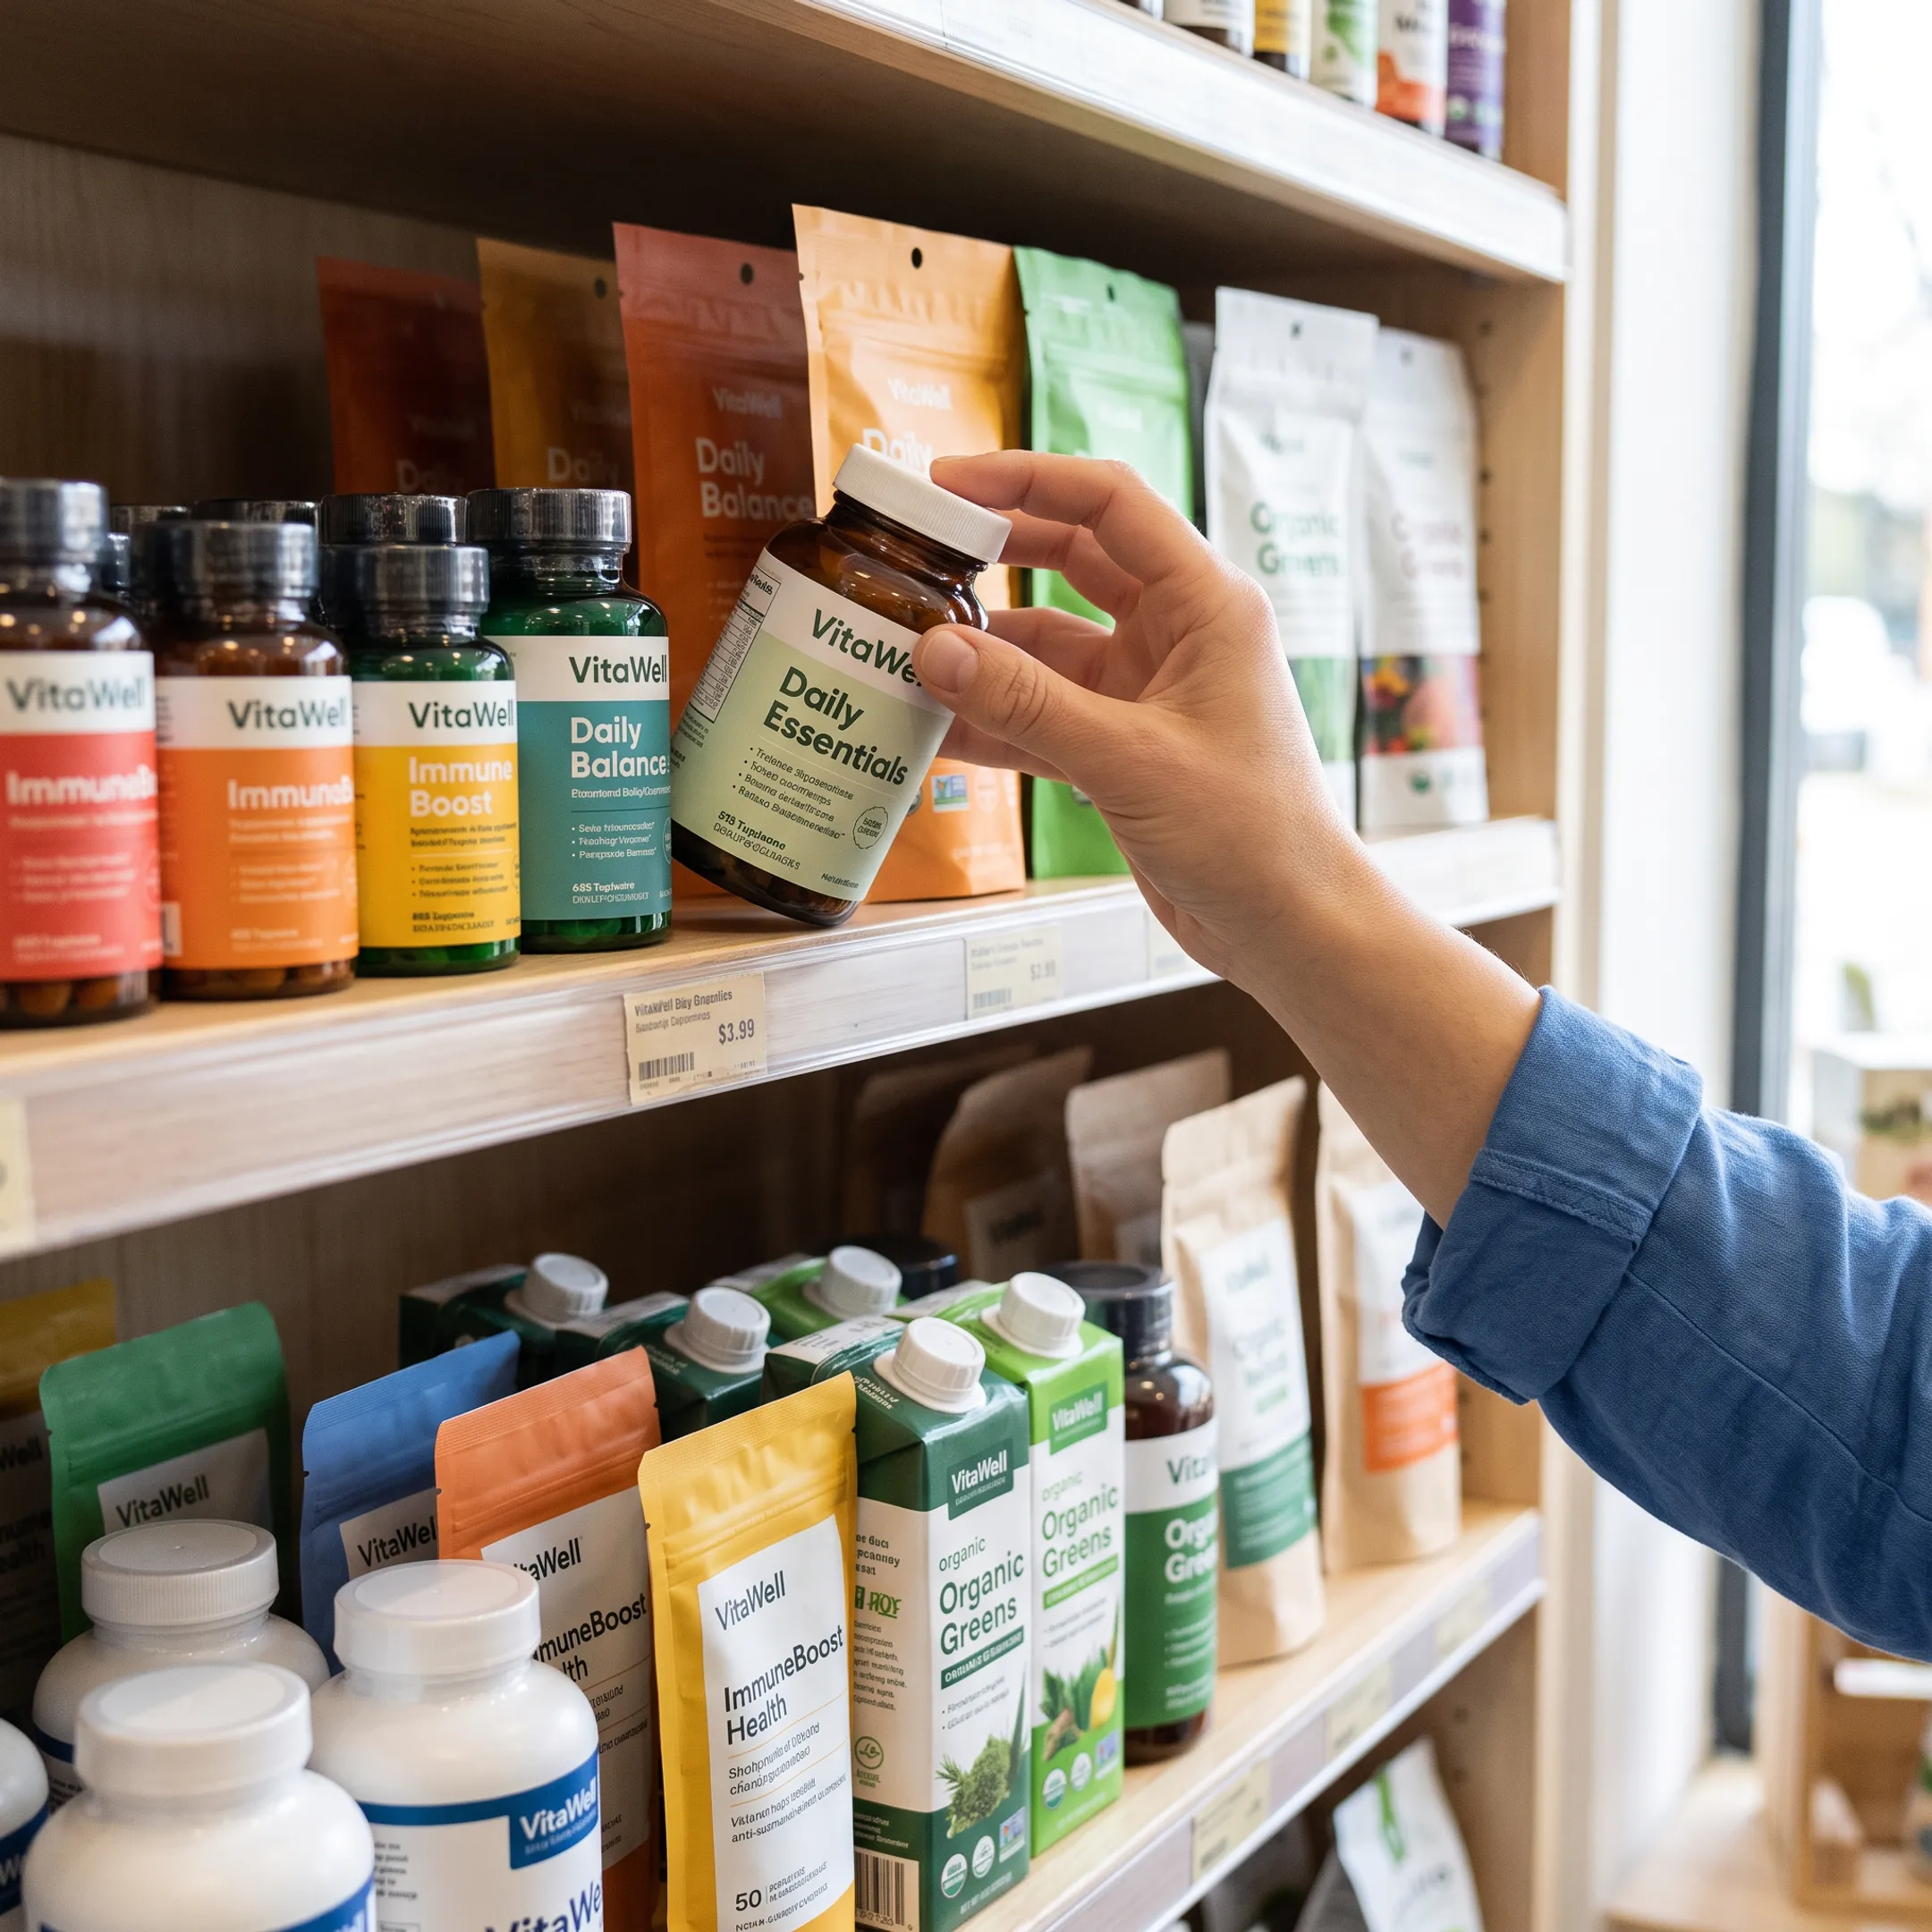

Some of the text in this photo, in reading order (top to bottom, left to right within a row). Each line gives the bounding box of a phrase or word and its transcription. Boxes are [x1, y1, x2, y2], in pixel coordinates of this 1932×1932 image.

[695, 437, 765, 487] Daily
[568, 655, 668, 684] VitaWell
[812, 608, 925, 689] VitaWe
[7, 676, 148, 715] VitaWell
[228, 698, 349, 732] VitaWell
[408, 701, 515, 730] VitaWell
[781, 665, 865, 731] Daily
[571, 715, 643, 751] Daily
[762, 699, 910, 787] Essentials
[409, 756, 513, 786] Immune
[411, 790, 494, 818] Boost
[718, 1018, 755, 1046] $3.99
[1051, 1392, 1105, 1433] VitaWell
[951, 1449, 1009, 1495] VitaWell
[115, 1475, 211, 1530] VitaWell
[1042, 1484, 1120, 1542] Organic
[358, 1517, 436, 1568] VitaWel
[513, 1537, 582, 1581] aWell
[938, 1536, 987, 1573] organic
[1042, 1523, 1113, 1579] Greens
[715, 1569, 787, 1632] VitaWell
[939, 1550, 1025, 1615] Organic
[532, 1592, 648, 1664] muneBoost
[940, 1595, 1018, 1657] Greens
[724, 1625, 844, 1715] ImmuneBoost
[726, 1696, 788, 1747] Health
[520, 1776, 597, 1841] VitaWell
[735, 1888, 762, 1912] 50
